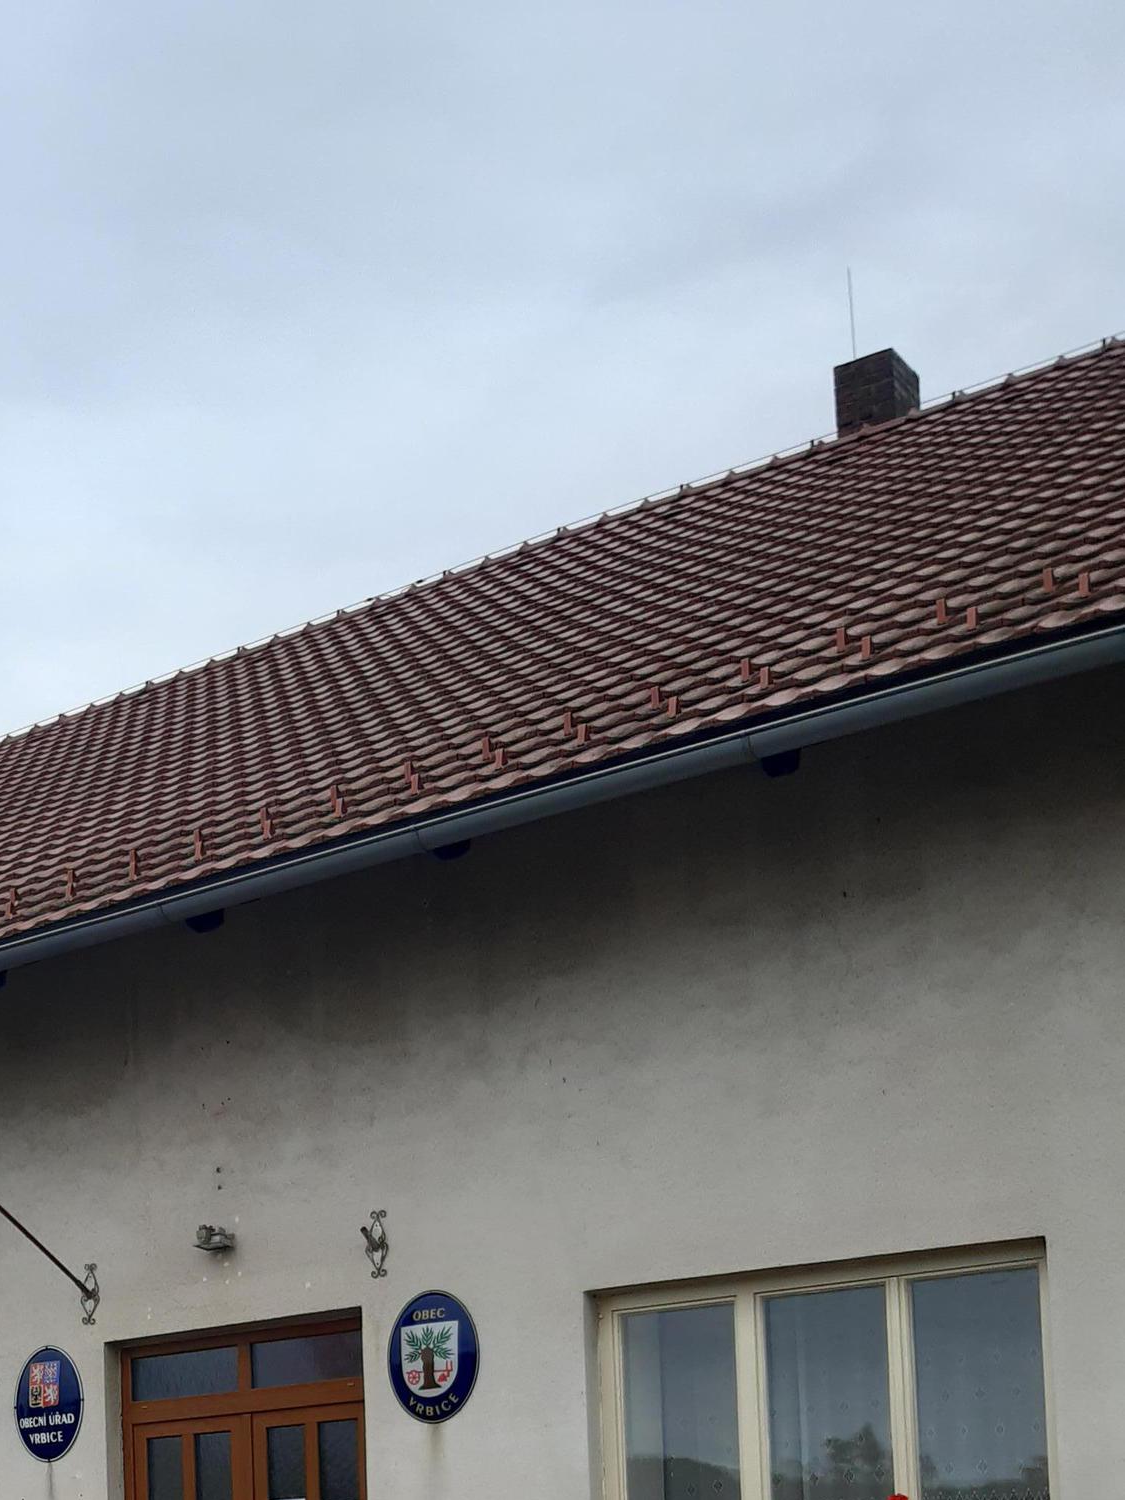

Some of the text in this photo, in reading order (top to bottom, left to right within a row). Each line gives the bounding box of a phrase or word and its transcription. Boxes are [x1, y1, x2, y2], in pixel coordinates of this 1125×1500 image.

[412, 1307, 446, 1321] OBEC
[408, 1392, 459, 1417] VRBICE
[19, 1410, 75, 1429] OBECNÍ ÚŘAD
[29, 1430, 64, 1445] VRBICE
